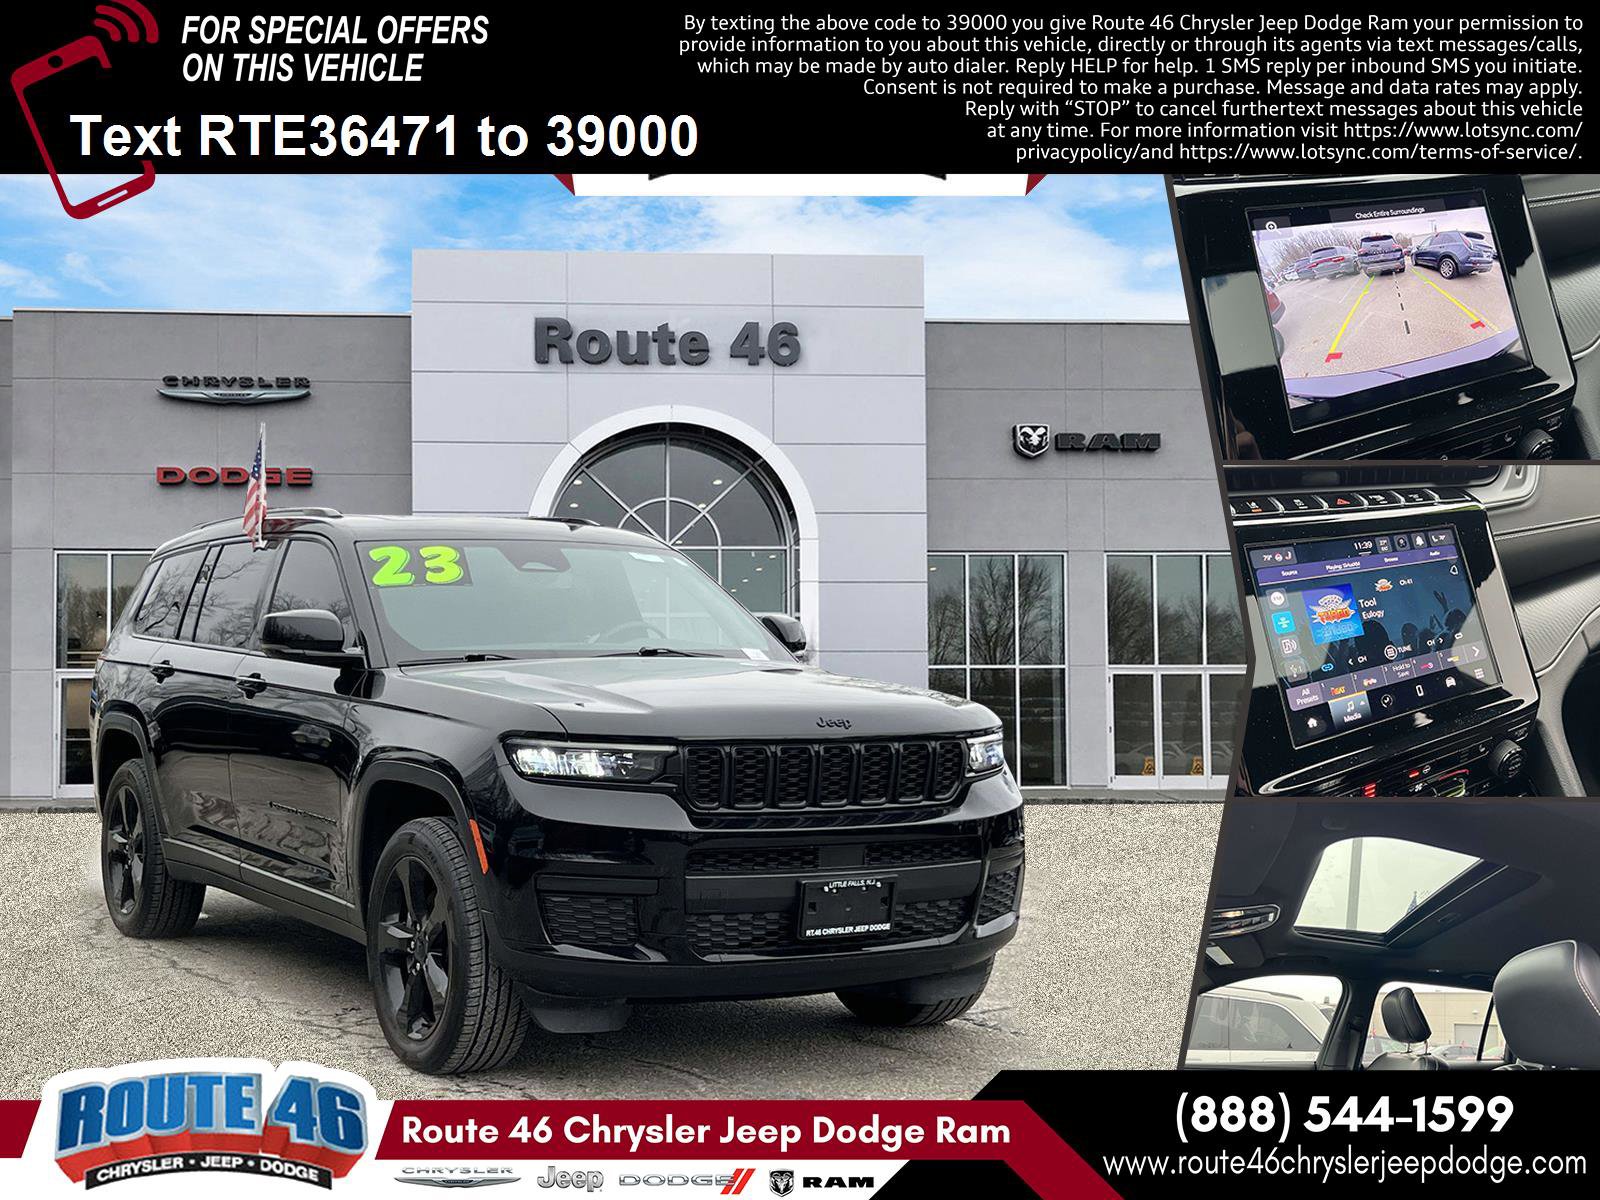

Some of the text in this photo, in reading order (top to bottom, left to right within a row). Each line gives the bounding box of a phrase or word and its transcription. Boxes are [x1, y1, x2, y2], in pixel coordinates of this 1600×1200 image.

[533, 316, 801, 367] Route 46
[161, 374, 311, 388] CHRYSLER
[1054, 431, 1162, 451] RAM
[155, 465, 314, 487] DODGE
[1353, 540, 1373, 550] 11:39
[1358, 597, 1378, 608] Tool
[1361, 609, 1385, 620] Eulogy
[1296, 694, 1320, 706] Presets
[815, 716, 852, 730] Jeep
[1343, 712, 1362, 723] Media
[828, 880, 847, 889] LITTLE
[854, 924, 869, 933] JEEP
[869, 922, 891, 932] DODGE
